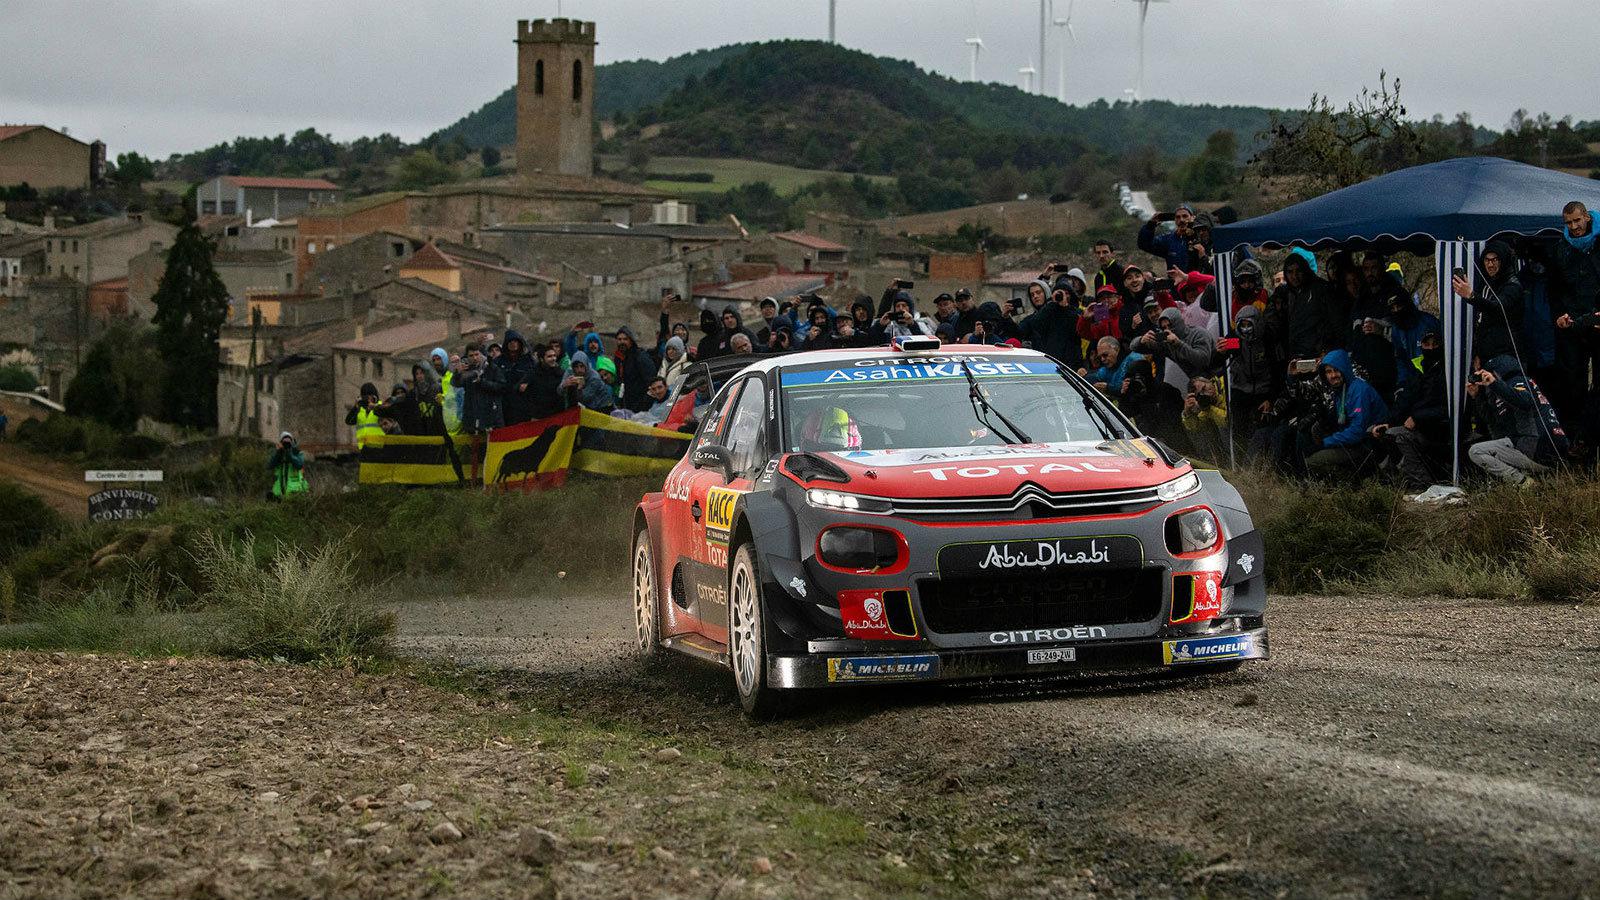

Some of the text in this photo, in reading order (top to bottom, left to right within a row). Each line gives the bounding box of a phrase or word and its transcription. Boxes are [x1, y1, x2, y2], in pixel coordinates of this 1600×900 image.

[695, 452, 720, 460] TOTAL
[913, 462, 1121, 481] TOTAL
[89, 489, 159, 505] BENVINGUTS
[92, 509, 150, 521] CONES
[708, 493, 734, 526] RACC
[706, 541, 728, 568] TOTA
[990, 625, 1107, 644] CITROËN
[1194, 642, 1248, 655] MICHELIN
[858, 663, 930, 674] MICHELIN
